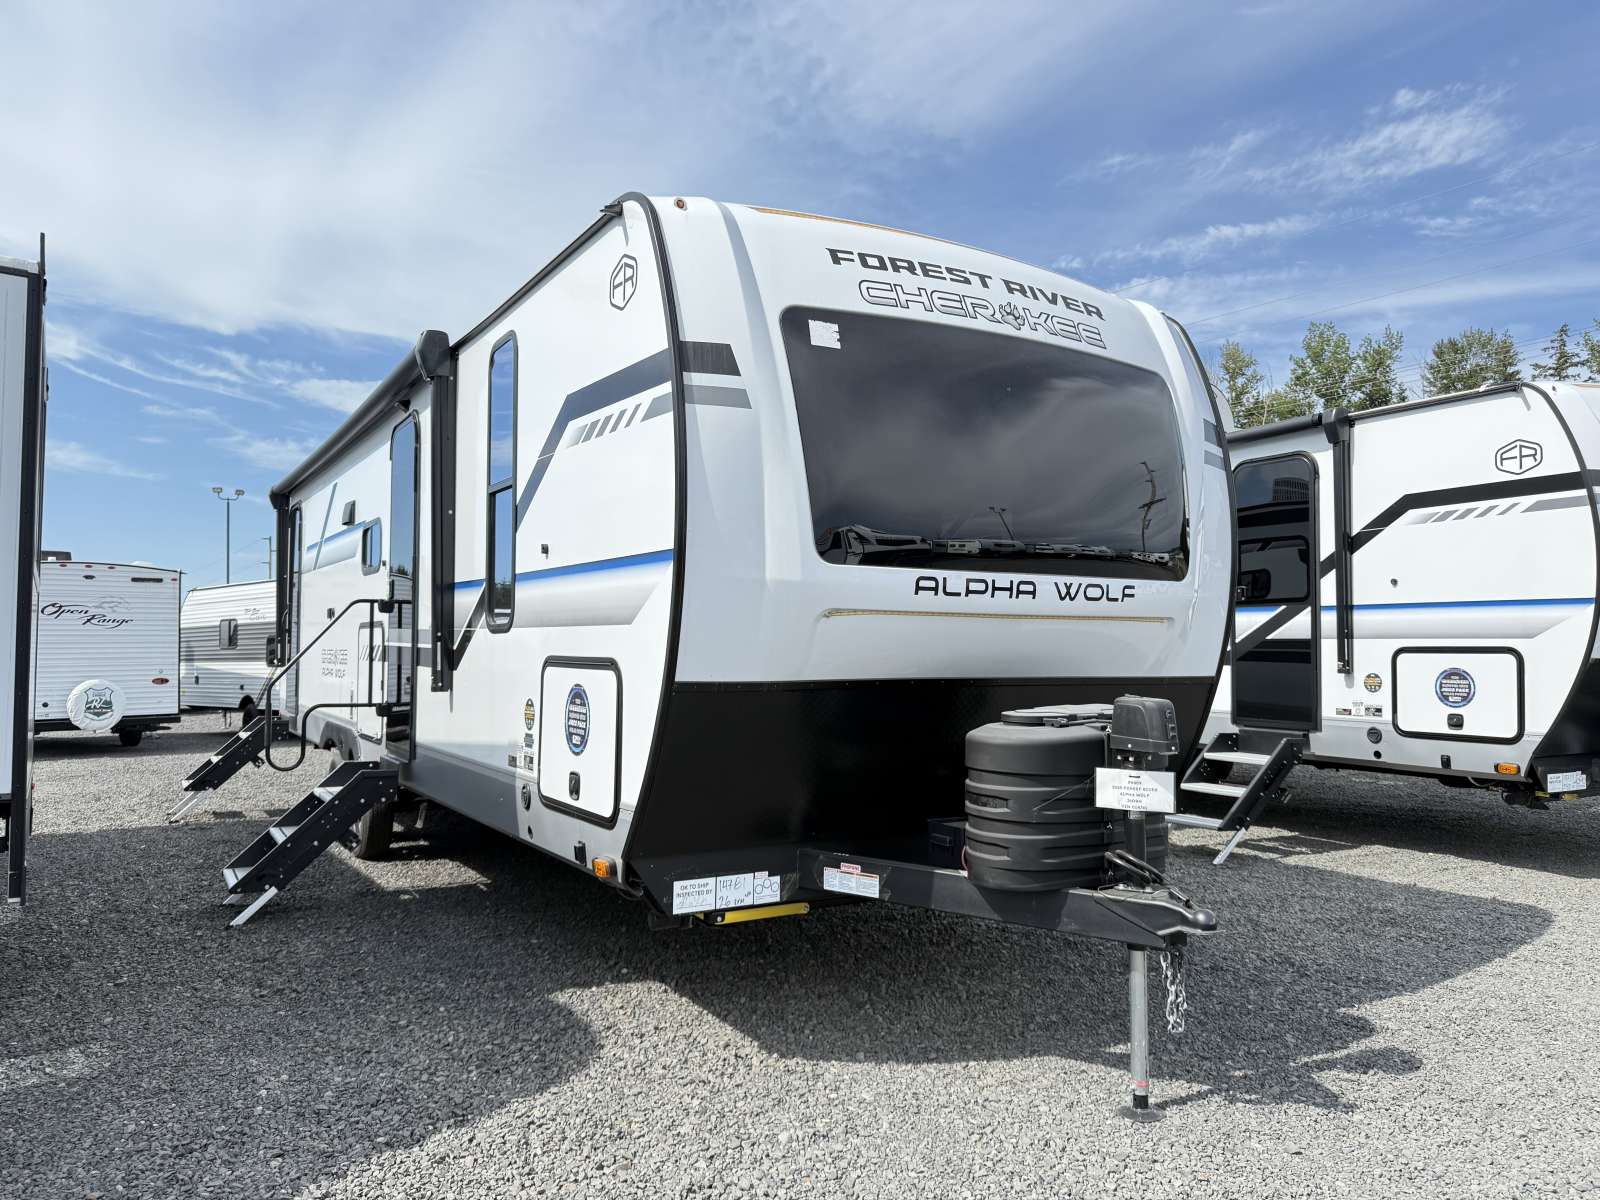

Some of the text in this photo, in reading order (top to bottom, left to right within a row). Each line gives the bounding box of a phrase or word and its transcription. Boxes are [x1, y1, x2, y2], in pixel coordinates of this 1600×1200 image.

[825, 247, 1105, 321] FOREST RIVER
[914, 575, 1136, 602] ALPHA WOLF
[40, 602, 89, 619] Open
[80, 613, 135, 629] Range
[676, 889, 704, 898] INSPECTED
